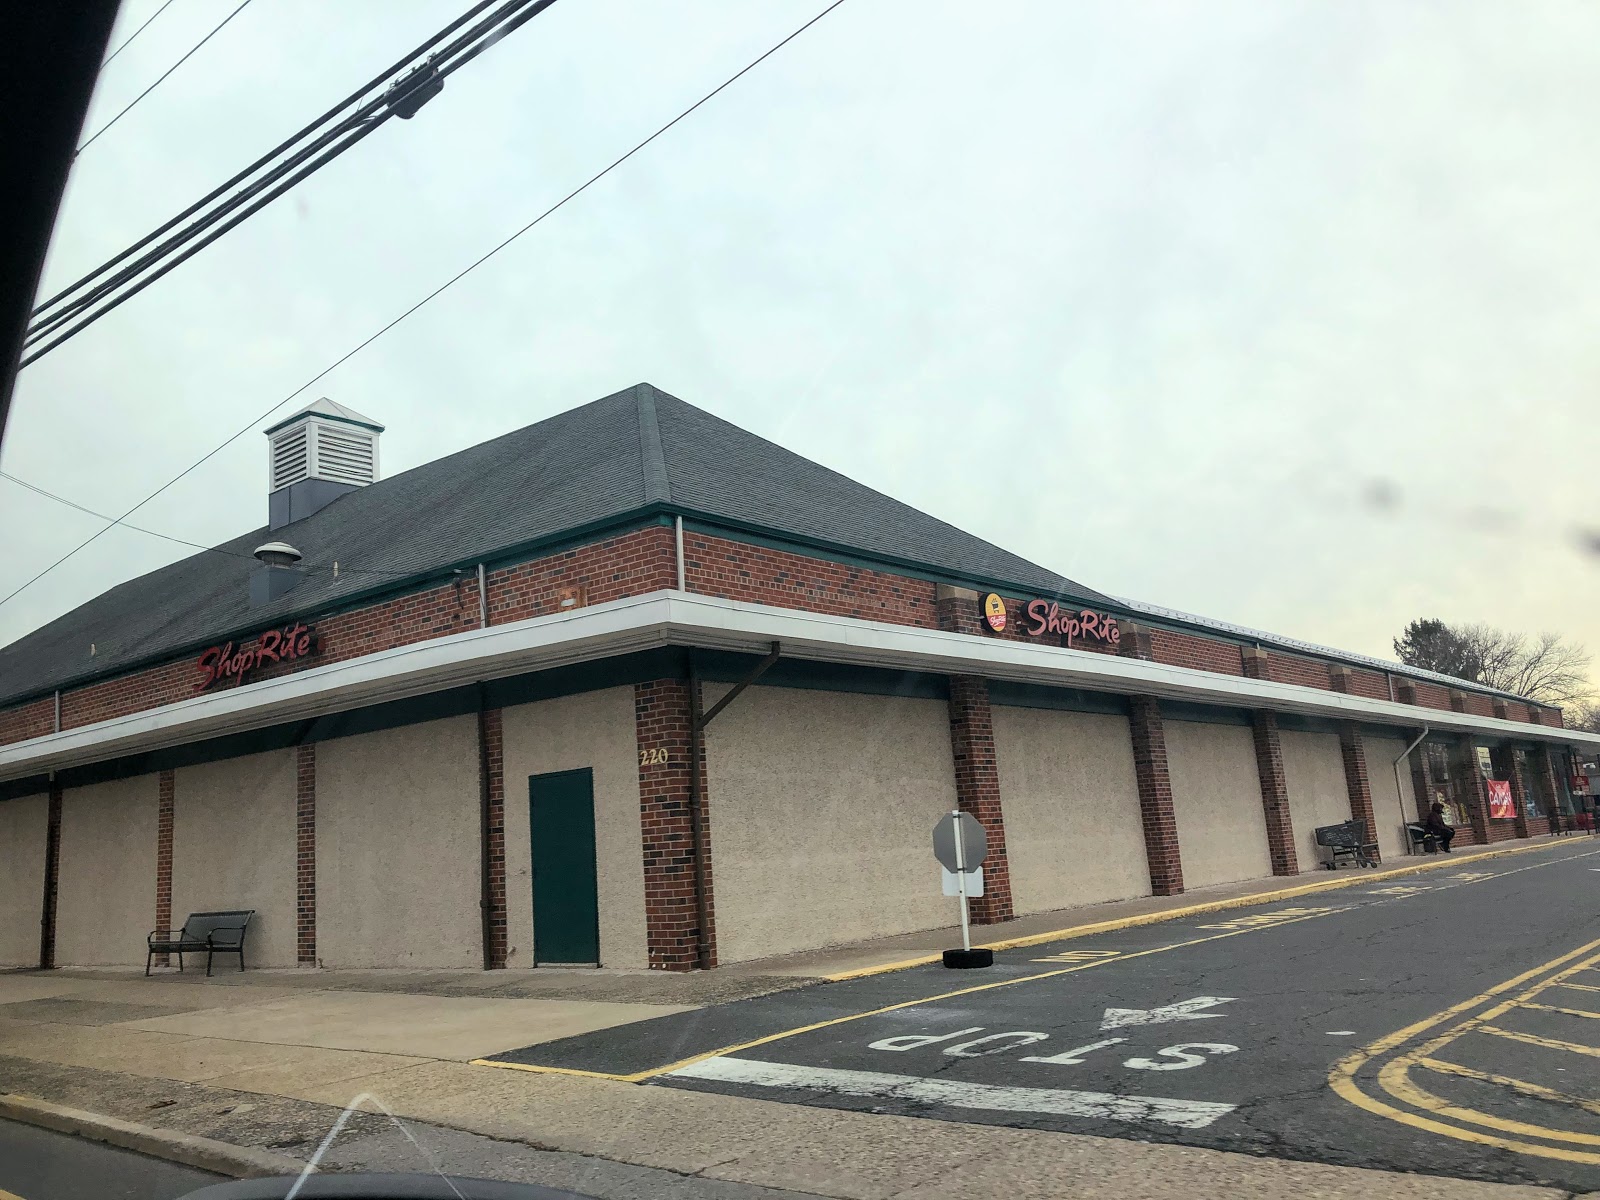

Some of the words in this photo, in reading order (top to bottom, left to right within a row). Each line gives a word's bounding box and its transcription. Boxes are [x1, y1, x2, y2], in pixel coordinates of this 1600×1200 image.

[1027, 599, 1120, 647] ShopRite
[192, 621, 310, 691] ShopRite
[640, 748, 668, 766] 220
[868, 1027, 1240, 1072] STOP
